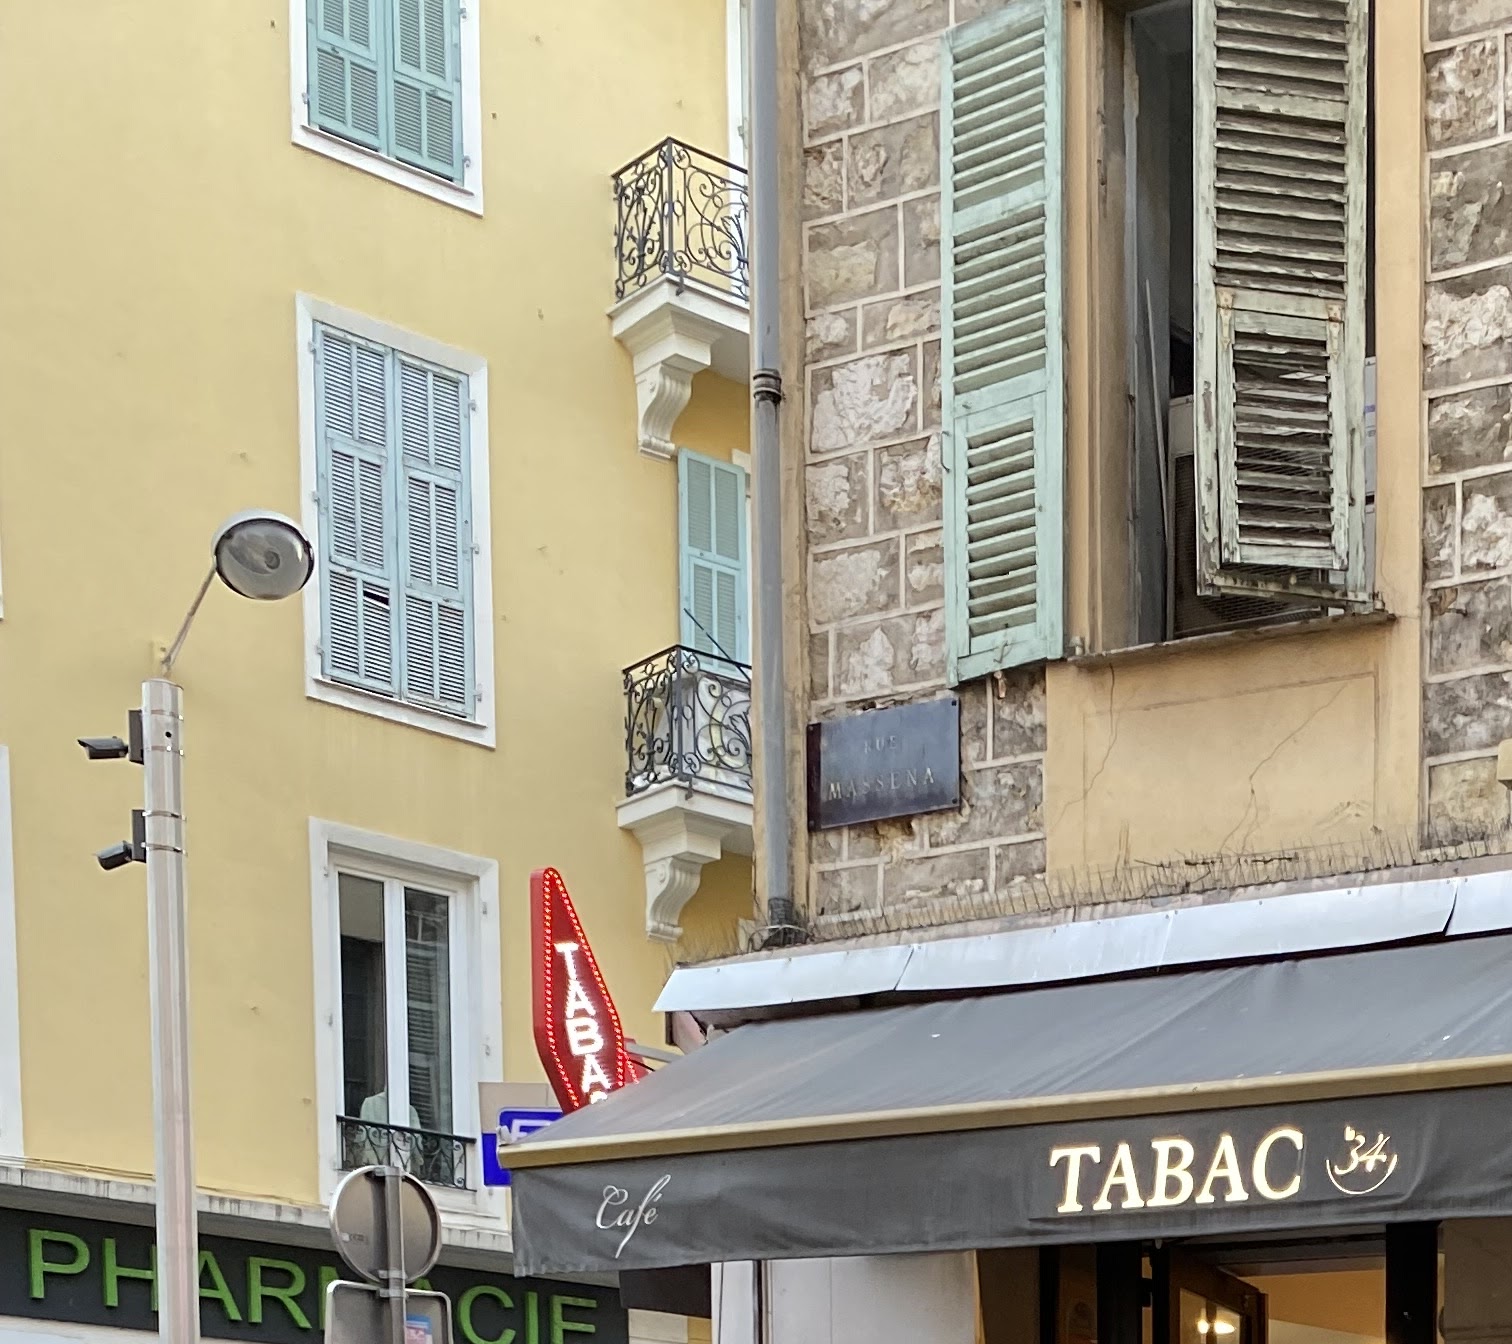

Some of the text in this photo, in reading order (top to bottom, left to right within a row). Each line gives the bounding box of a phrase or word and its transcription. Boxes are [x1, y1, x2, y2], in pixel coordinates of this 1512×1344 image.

[863, 735, 897, 755] RUE
[828, 767, 934, 801] MASSENA
[1049, 1127, 1304, 1213] TABAC
[596, 1174, 671, 1259] Café
